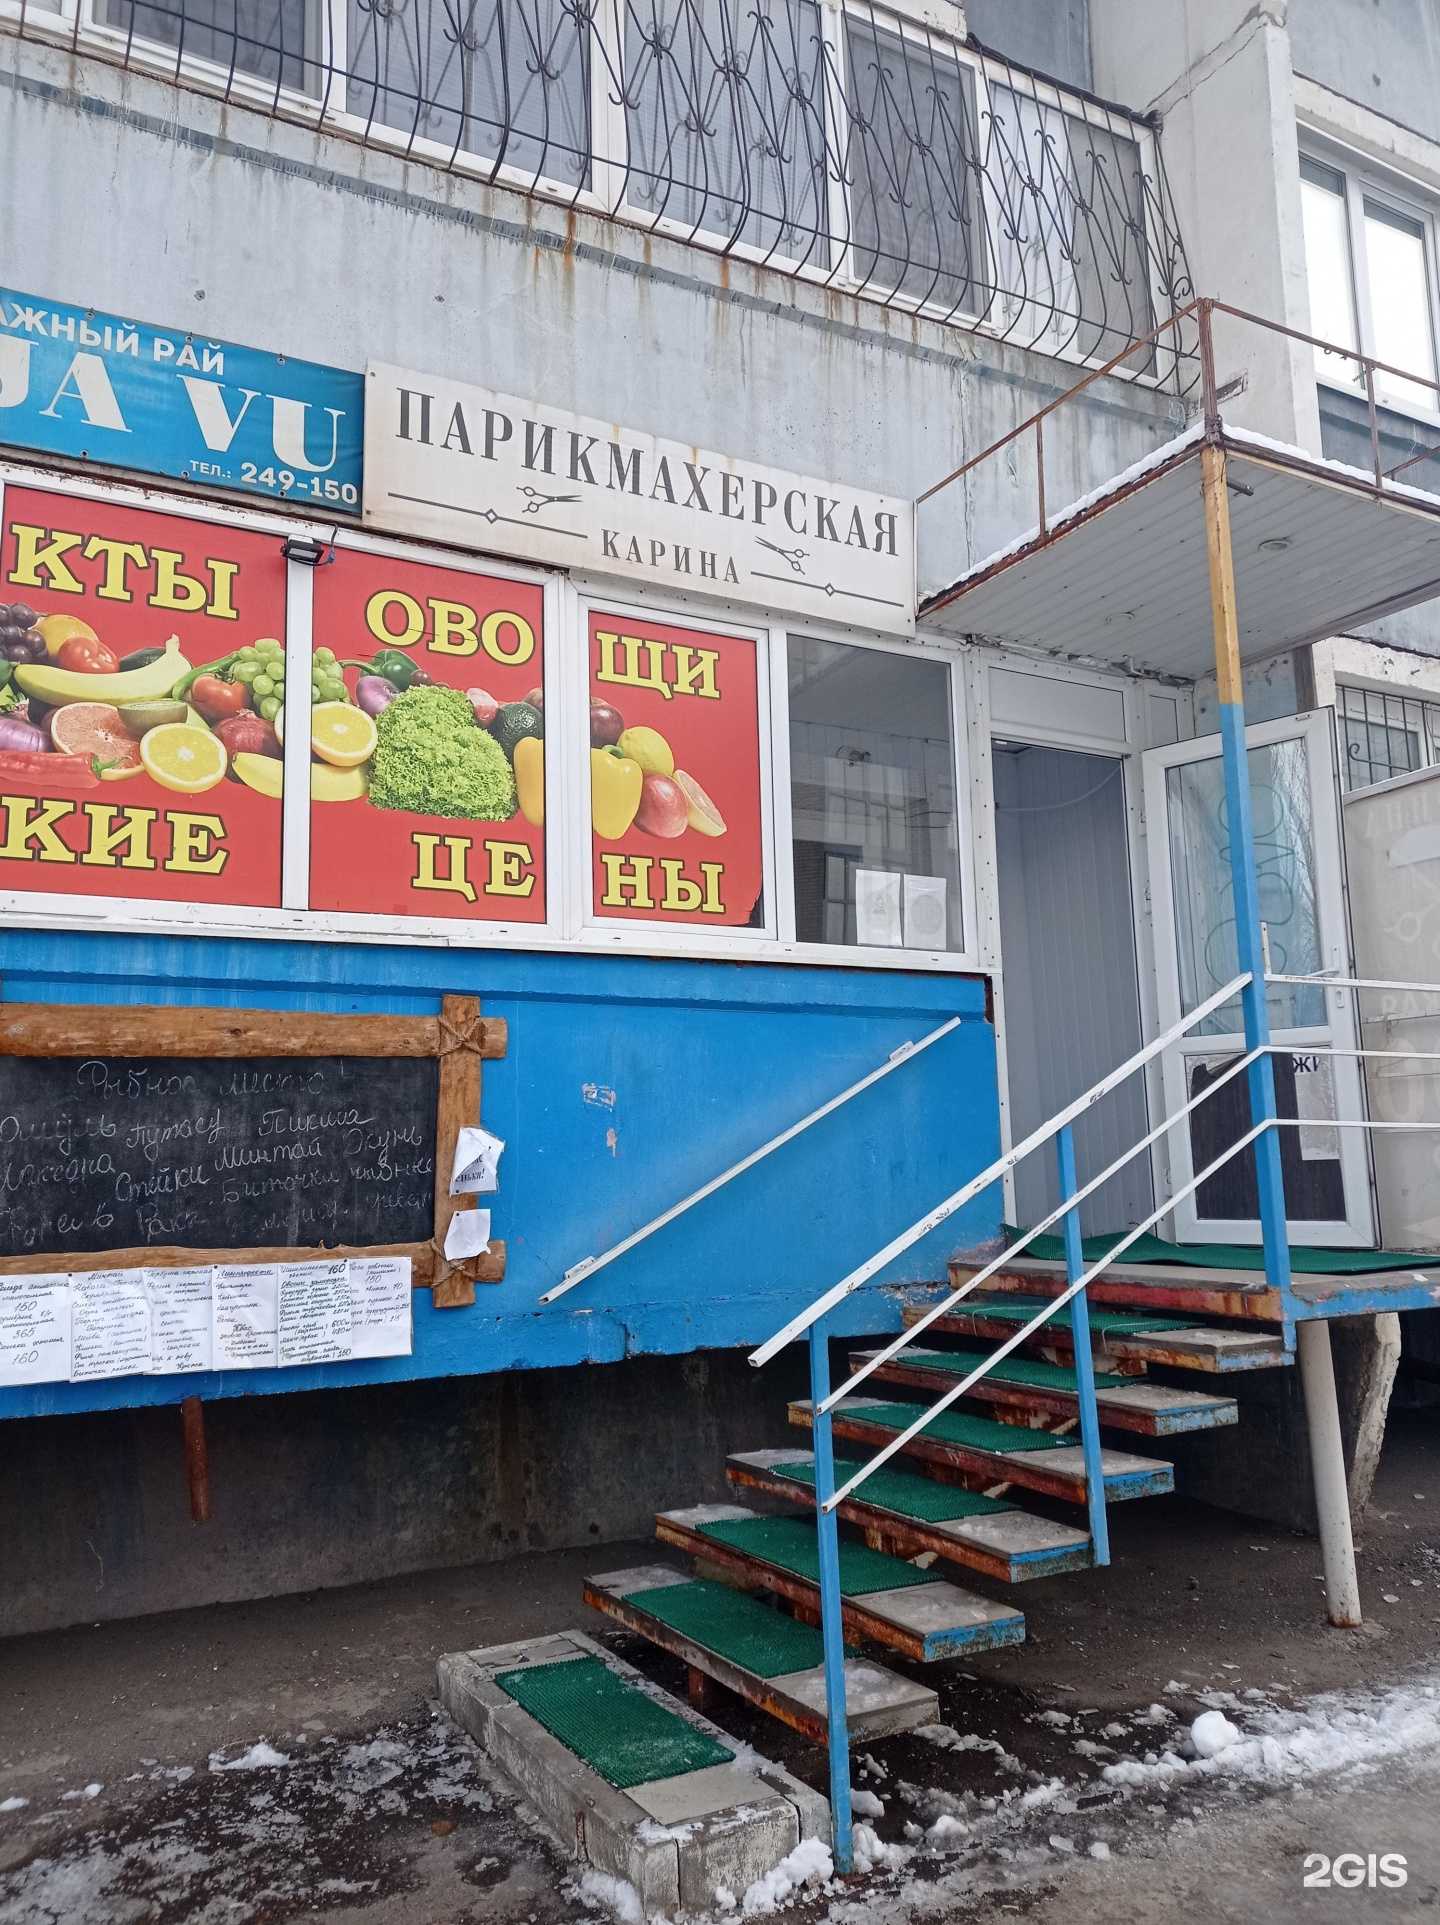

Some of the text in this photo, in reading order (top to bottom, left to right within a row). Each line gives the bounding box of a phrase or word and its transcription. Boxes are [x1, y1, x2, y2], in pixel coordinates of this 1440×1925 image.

[153, 337, 225, 376] РАЙ
[177, 374, 346, 473] VU
[240, 461, 358, 505] 249-150
[396, 388, 899, 557] ПАРИКМАХЕРСКАЯ
[8, 522, 240, 620] КТЫ
[601, 527, 740, 585] КАРИНА
[328, 1264, 346, 1275] 160
